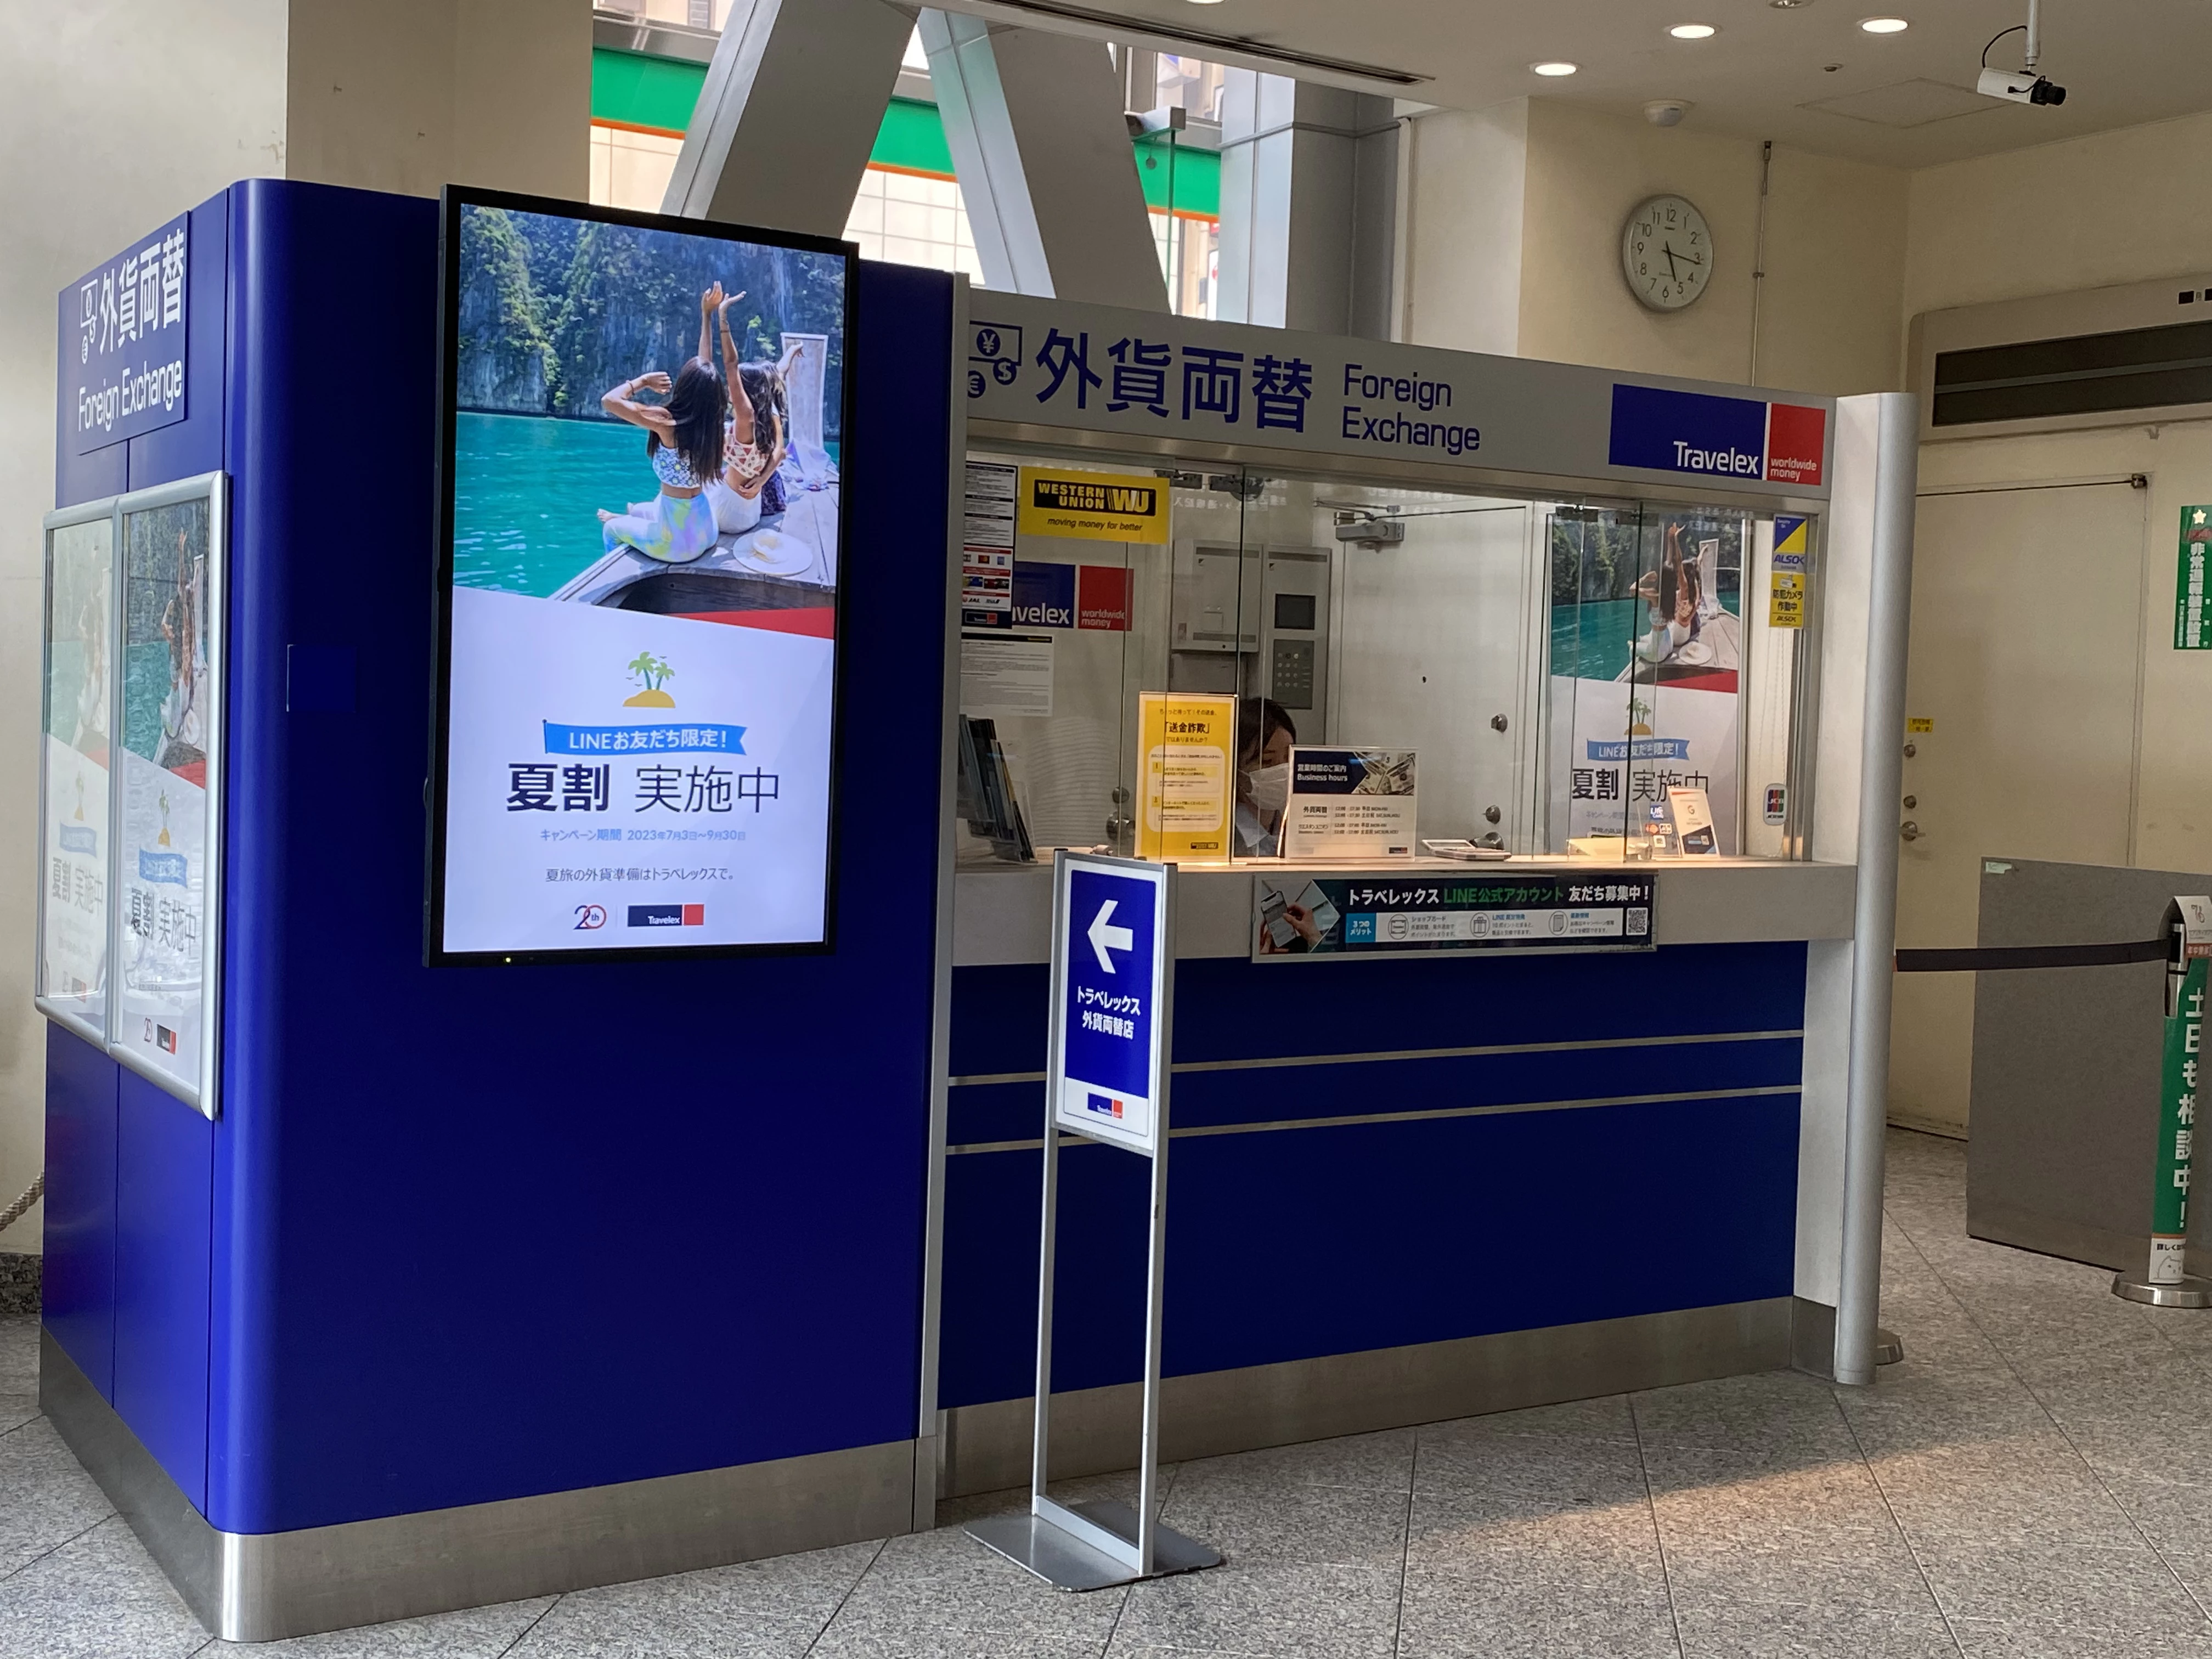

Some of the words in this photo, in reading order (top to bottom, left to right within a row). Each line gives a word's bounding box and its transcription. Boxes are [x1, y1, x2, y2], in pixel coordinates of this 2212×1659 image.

[1653, 211, 1661, 225] 11
[1667, 207, 1677, 223] 12
[1641, 222, 1652, 237] 10
[1691, 231, 1697, 245] 2
[1637, 241, 1644, 255] 9
[1694, 252, 1700, 264] 3
[1640, 262, 1647, 275] 8
[1651, 278, 1657, 290] 7
[1688, 272, 1694, 283] 4
[100, 228, 184, 356] 外貨両替
[1662, 285, 1669, 298] 6
[1677, 281, 1684, 295] 5
[1035, 328, 1313, 433] 外貨両替
[1344, 363, 1452, 413] Foreign
[78, 377, 119, 432] Foreign
[121, 360, 182, 416] Exchange
[1341, 406, 1481, 455] Exchange
[1673, 441, 1758, 475] Travelex
[1770, 456, 1818, 471] worldwide
[1770, 468, 1801, 482] money
[1037, 482, 1104, 499] WESTERN
[1111, 488, 1150, 514] WU
[1058, 495, 1104, 510] UNION
[1047, 517, 1076, 529] moving
[1078, 520, 1105, 531] money
[1107, 520, 1118, 529] for
[1119, 523, 1143, 532] better
[1773, 554, 1804, 567] ALSOK
[1081, 618, 1111, 629] money
[569, 728, 726, 751] LINEお友だち限定！
[1297, 774, 1327, 782] Business
[1328, 774, 1348, 782] hours
[1572, 768, 1618, 800] 夏割
[506, 763, 611, 812] 夏割
[634, 764, 780, 814] 実施中
[540, 828, 622, 841] キャンペーン期間
[545, 867, 734, 882] 夏旅の外貨準備はトラベレックスで。
[1349, 888, 1440, 905] トラベレックス
[1568, 884, 1649, 902] 友だち募集中！
[158, 896, 197, 956] 実施中
[648, 915, 680, 925] Travelex
[1350, 927, 1372, 936] メリット
[1077, 985, 1141, 1015] トラベレックス
[1082, 1010, 1135, 1040] 外貨両替店
